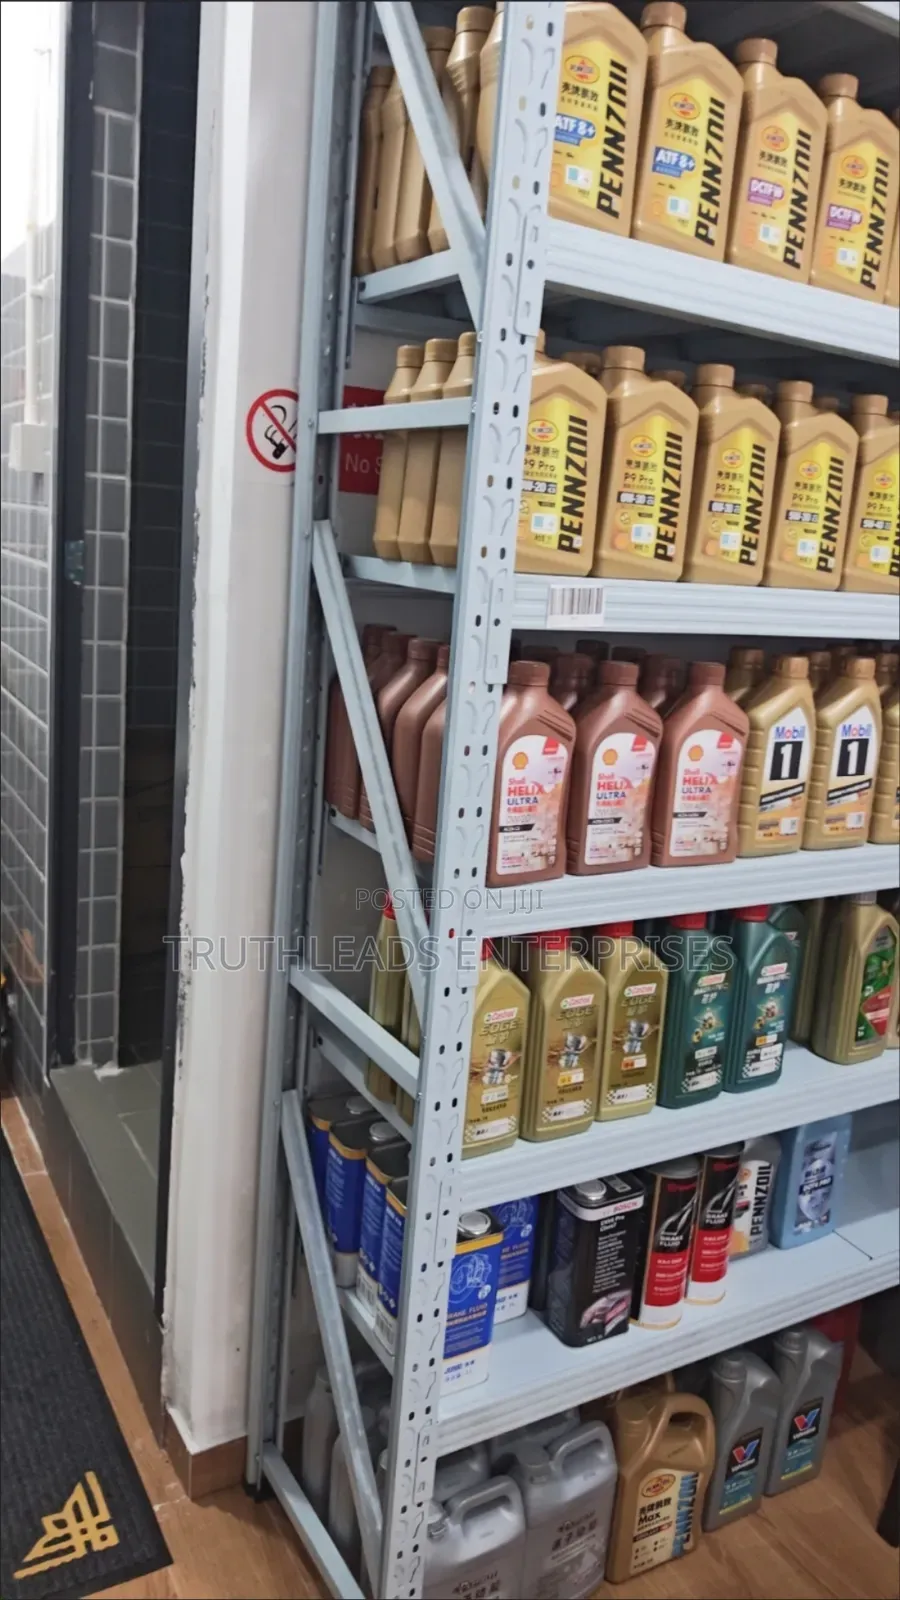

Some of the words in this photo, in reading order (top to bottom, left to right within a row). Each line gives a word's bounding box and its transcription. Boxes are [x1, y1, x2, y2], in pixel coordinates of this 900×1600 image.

[345, 453, 370, 473] No
[774, 725, 806, 739] Mobil
[841, 723, 873, 737] Mobil
[596, 778, 634, 791] HELIX
[682, 773, 719, 786] HELIX
[507, 782, 544, 797] HELIX
[596, 791, 627, 800] ULTRA
[681, 786, 713, 794] ULTRA
[507, 797, 539, 806] ULTRA
[750, 1162, 773, 1237] PENNZOIL
[613, 1201, 638, 1212] BOSCH
[705, 1217, 727, 1226] FLUID
[659, 1240, 681, 1249] FLUID
[469, 1302, 488, 1313] FLUID
[638, 1512, 662, 1525] Max
